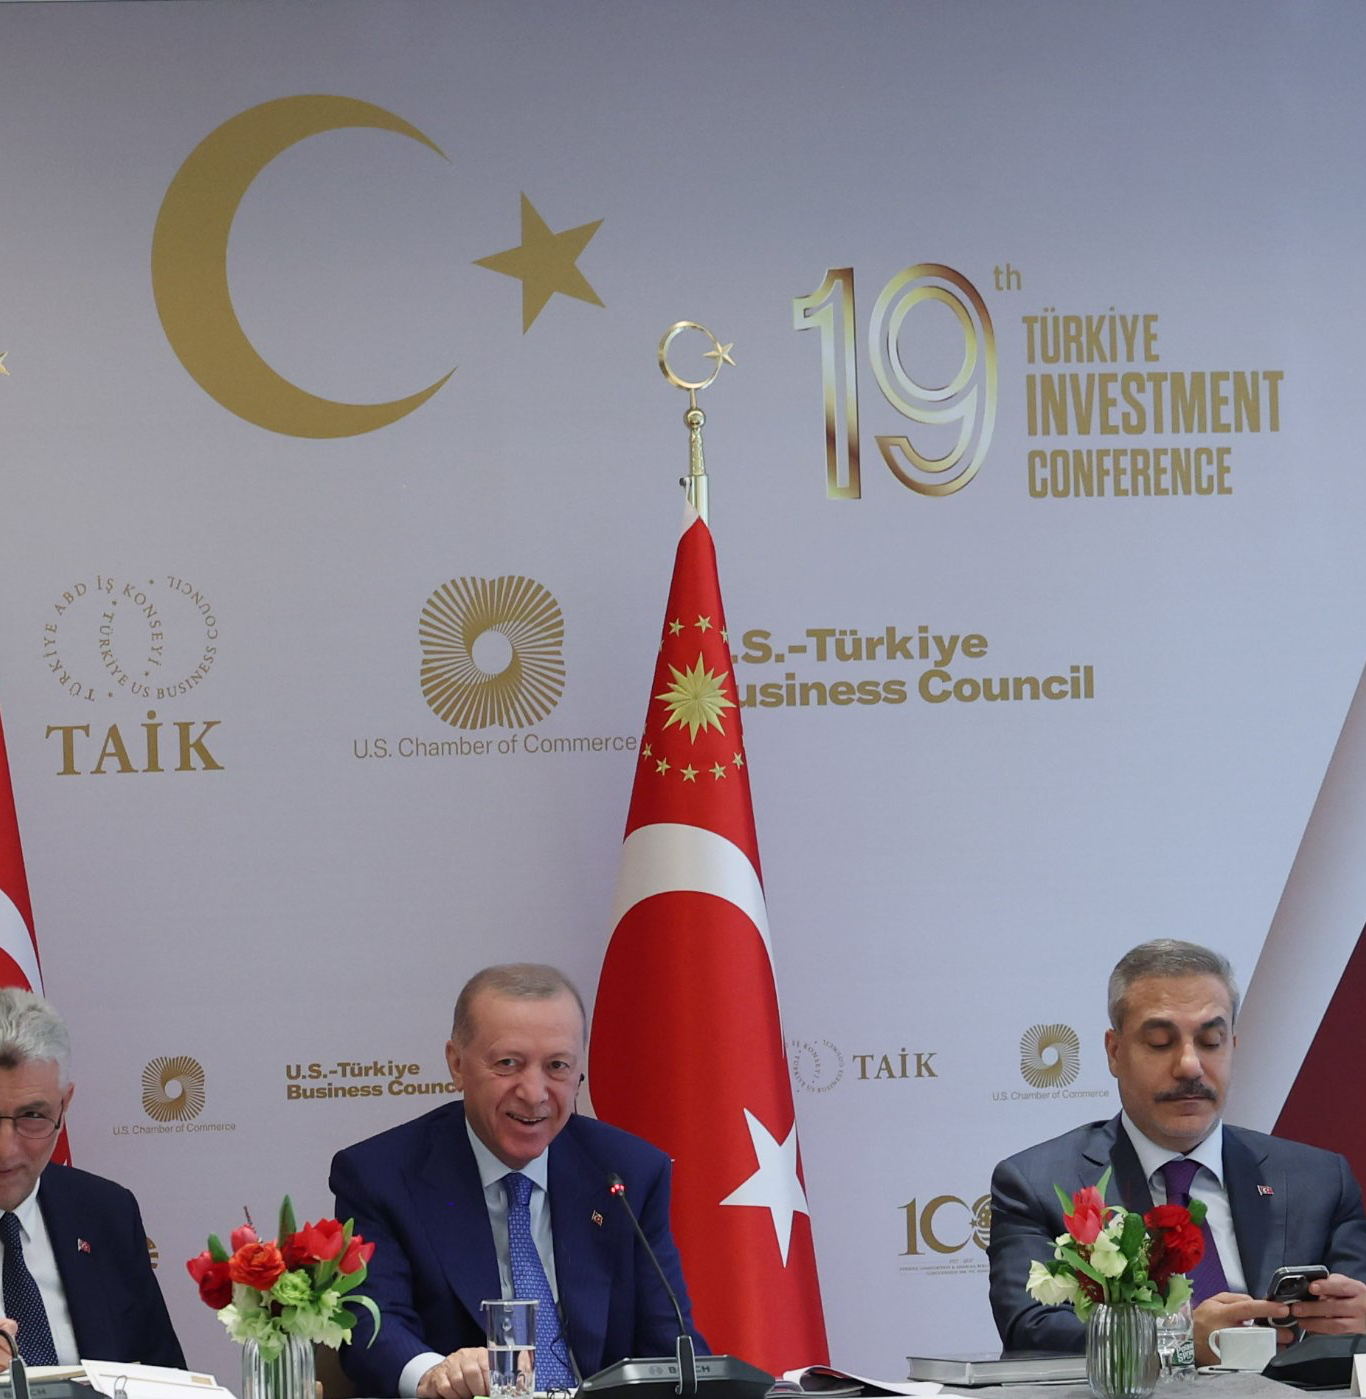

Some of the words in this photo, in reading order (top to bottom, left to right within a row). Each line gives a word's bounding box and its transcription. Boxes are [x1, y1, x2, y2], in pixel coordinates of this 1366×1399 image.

[1021, 306, 1159, 365] TÜRKİYE
[1025, 370, 1284, 437] INVESTMENT
[1027, 446, 1233, 499] CONFERENCE
[54, 583, 87, 616] ABD
[731, 625, 988, 668] .S.-Türkiye
[131, 682, 150, 698] US
[156, 645, 217, 700] BUSINESS
[736, 671, 908, 709] usiness
[917, 665, 1095, 705] Council
[45, 709, 225, 776] TAİK
[353, 737, 394, 760] U.S.
[398, 735, 490, 758] Chamber
[494, 732, 519, 755] of
[522, 732, 637, 756] Commerce
[286, 1060, 420, 1080] U.S.-Türkiye
[852, 1047, 938, 1080] TAİK
[287, 1082, 383, 1100] Business
[387, 1080, 464, 1096] Counc
[1010, 1090, 1050, 1101] Chamber
[1052, 1089, 1060, 1099] of
[1062, 1089, 1110, 1099] Commerce
[132, 1124, 174, 1135] Chamber
[176, 1123, 184, 1133] of
[186, 1123, 236, 1133] Commerce
